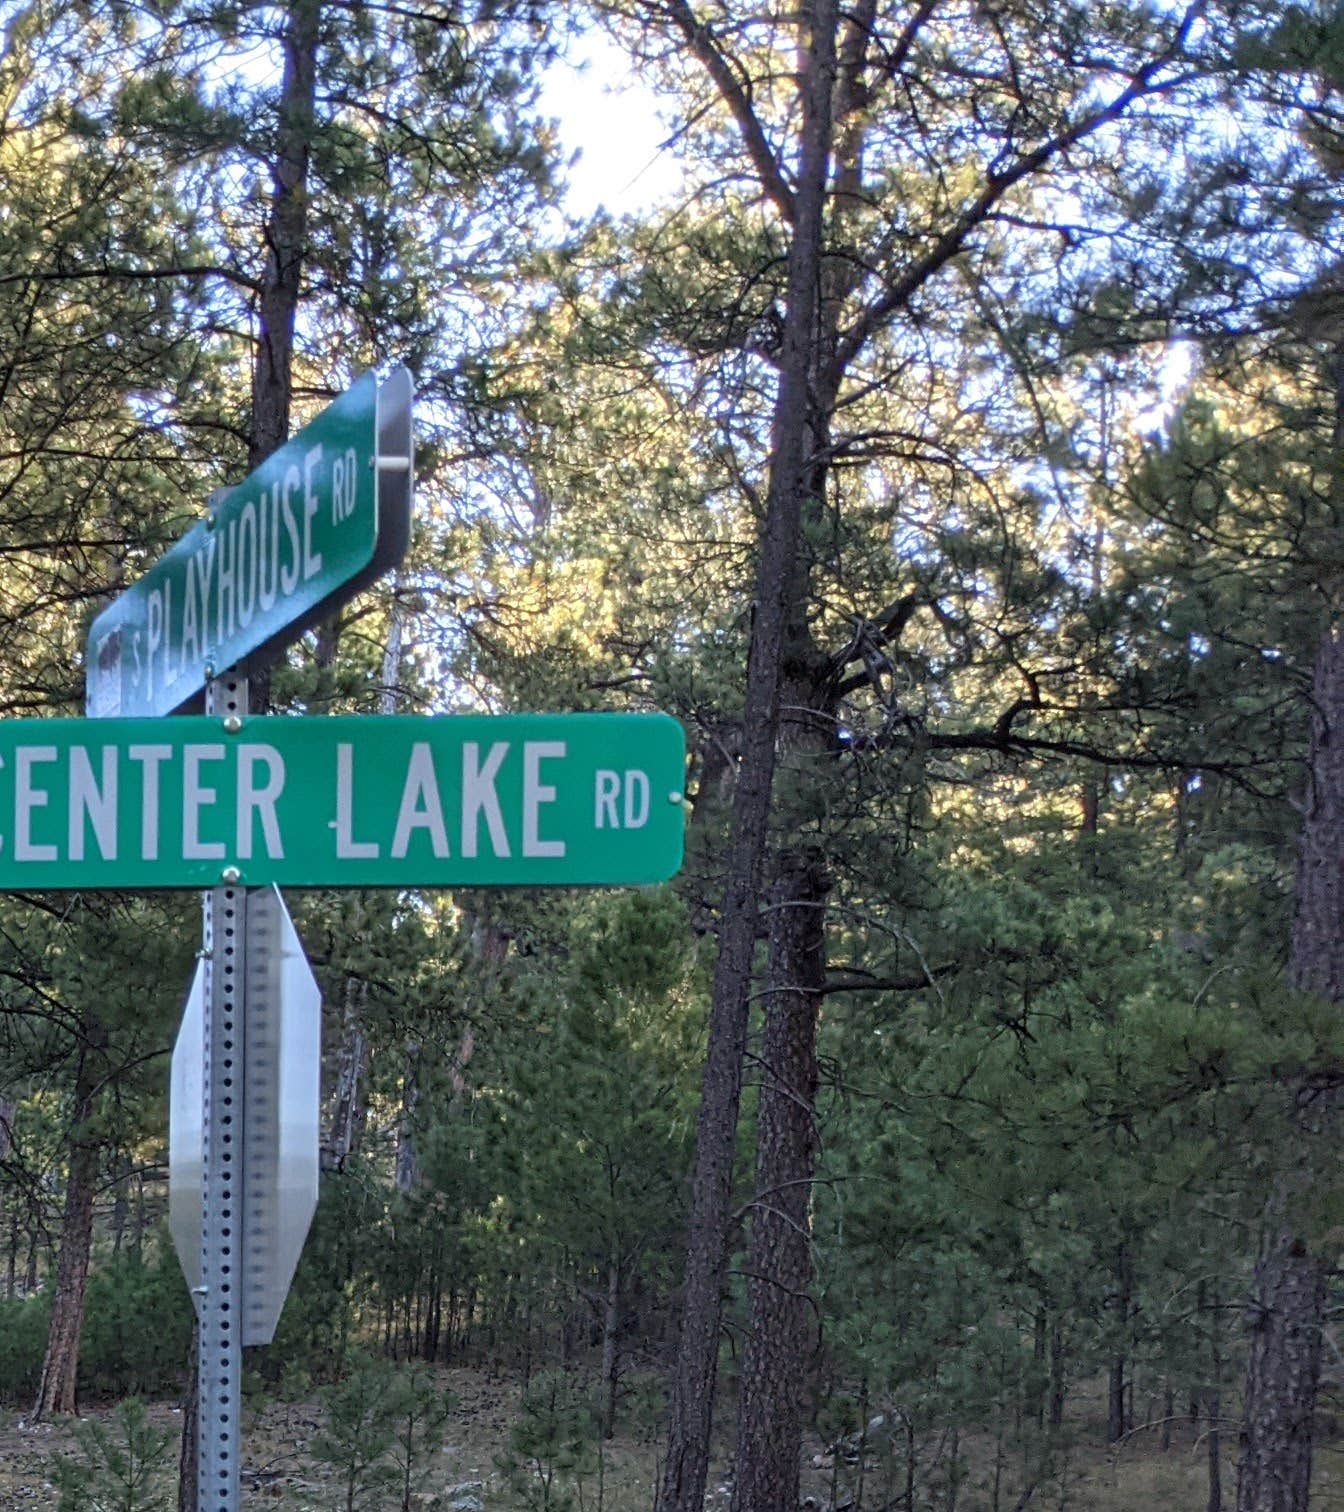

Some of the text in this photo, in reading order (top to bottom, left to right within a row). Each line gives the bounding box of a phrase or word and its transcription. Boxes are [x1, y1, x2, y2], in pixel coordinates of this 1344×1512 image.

[146, 443, 324, 702] PLAYHOUSE
[331, 447, 358, 527] RD
[335, 740, 568, 860] LAKE
[595, 769, 650, 829] RD
